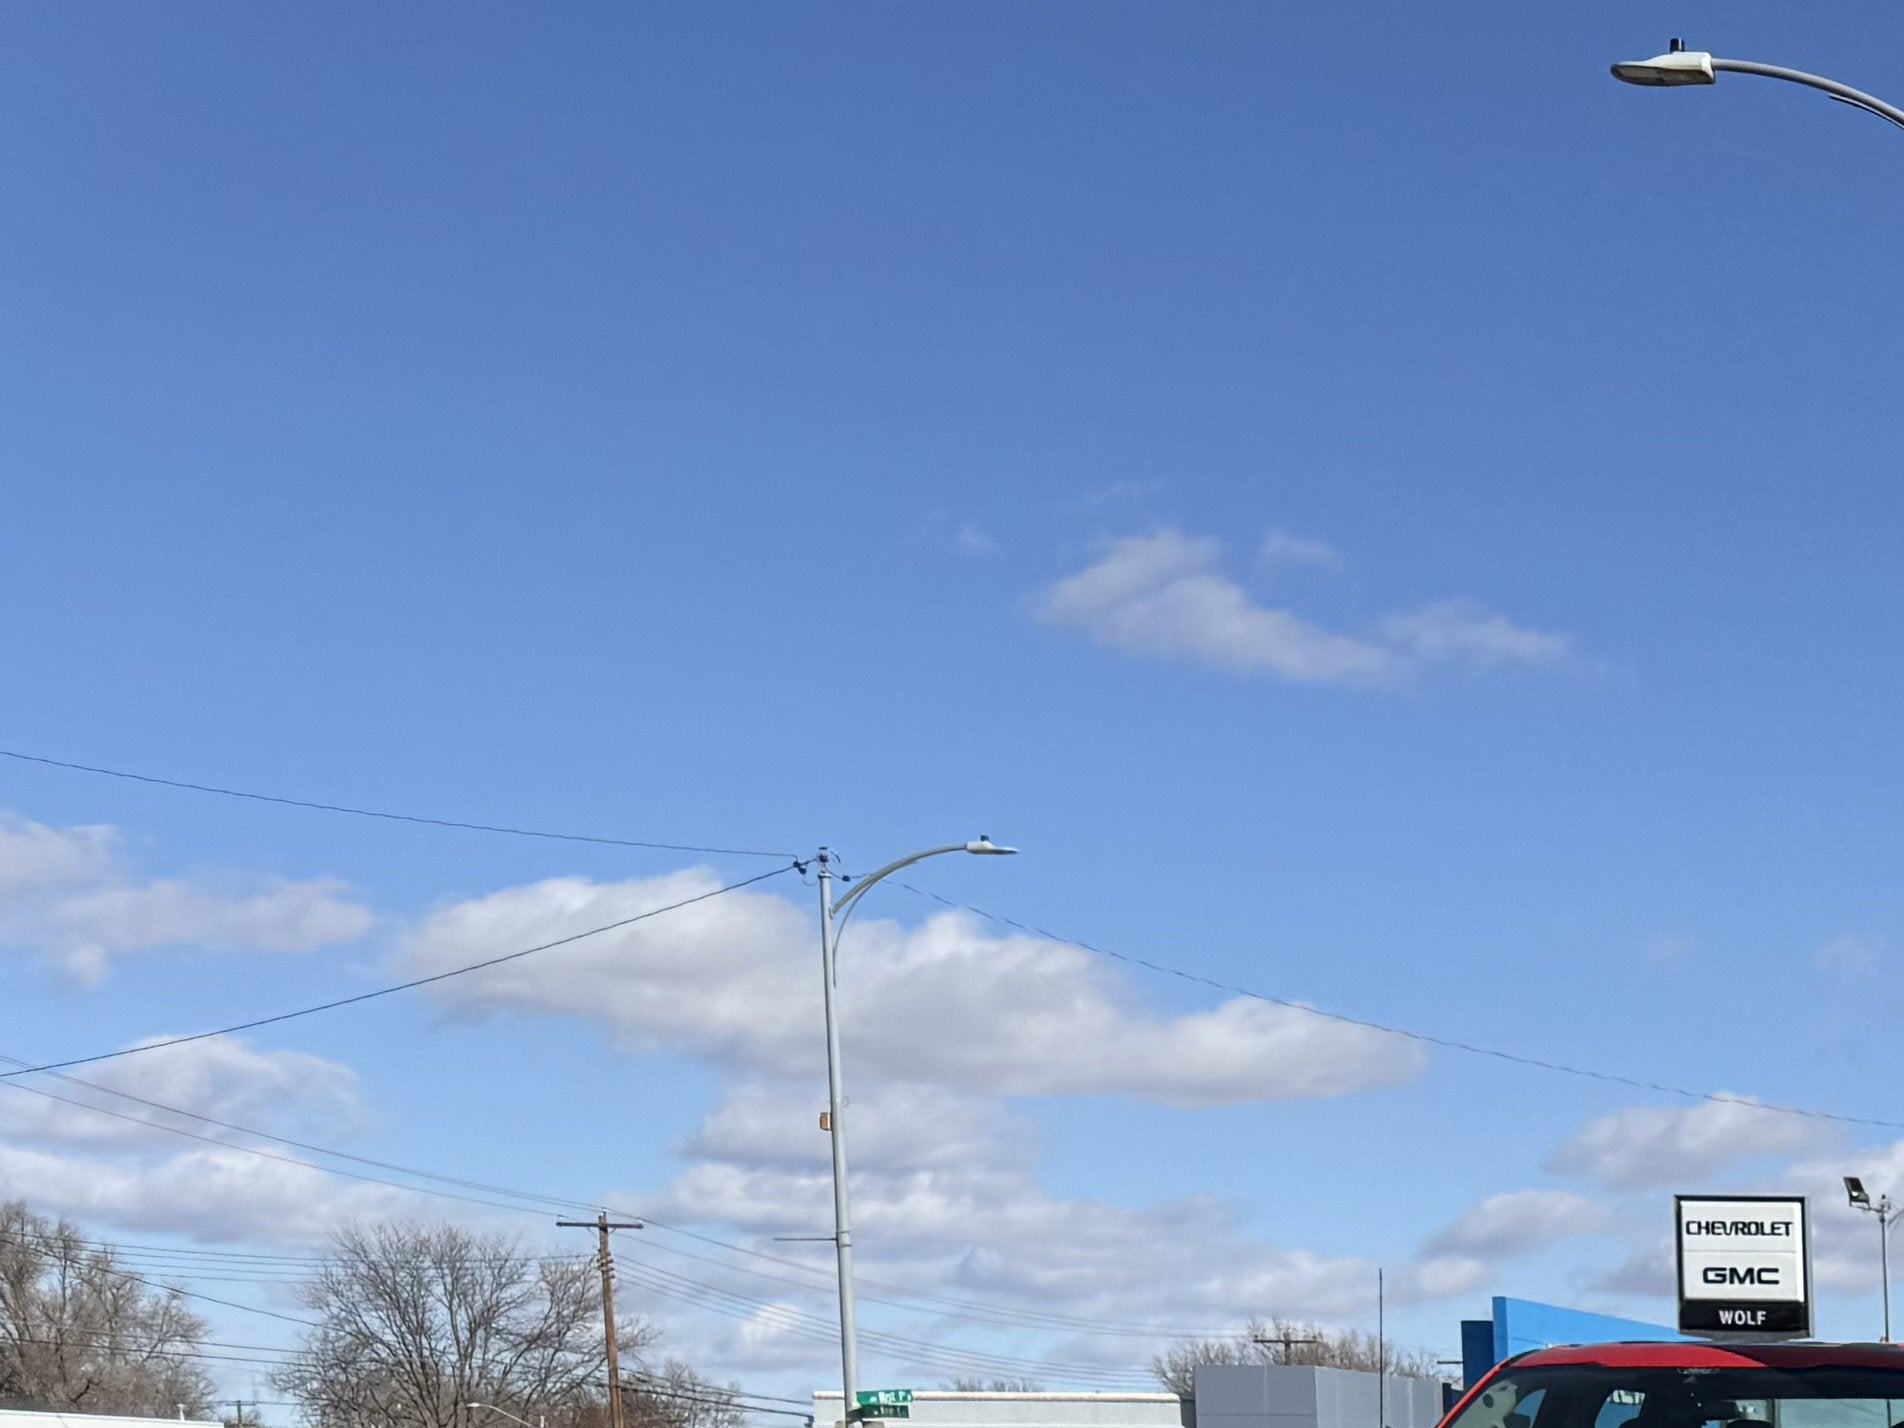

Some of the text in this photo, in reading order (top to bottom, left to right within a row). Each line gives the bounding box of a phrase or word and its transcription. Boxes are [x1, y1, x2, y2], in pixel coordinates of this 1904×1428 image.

[1686, 1220, 1793, 1237] CHEVROLET
[1703, 1267, 1780, 1285] GMC
[1718, 1309, 1767, 1326] WOLF
